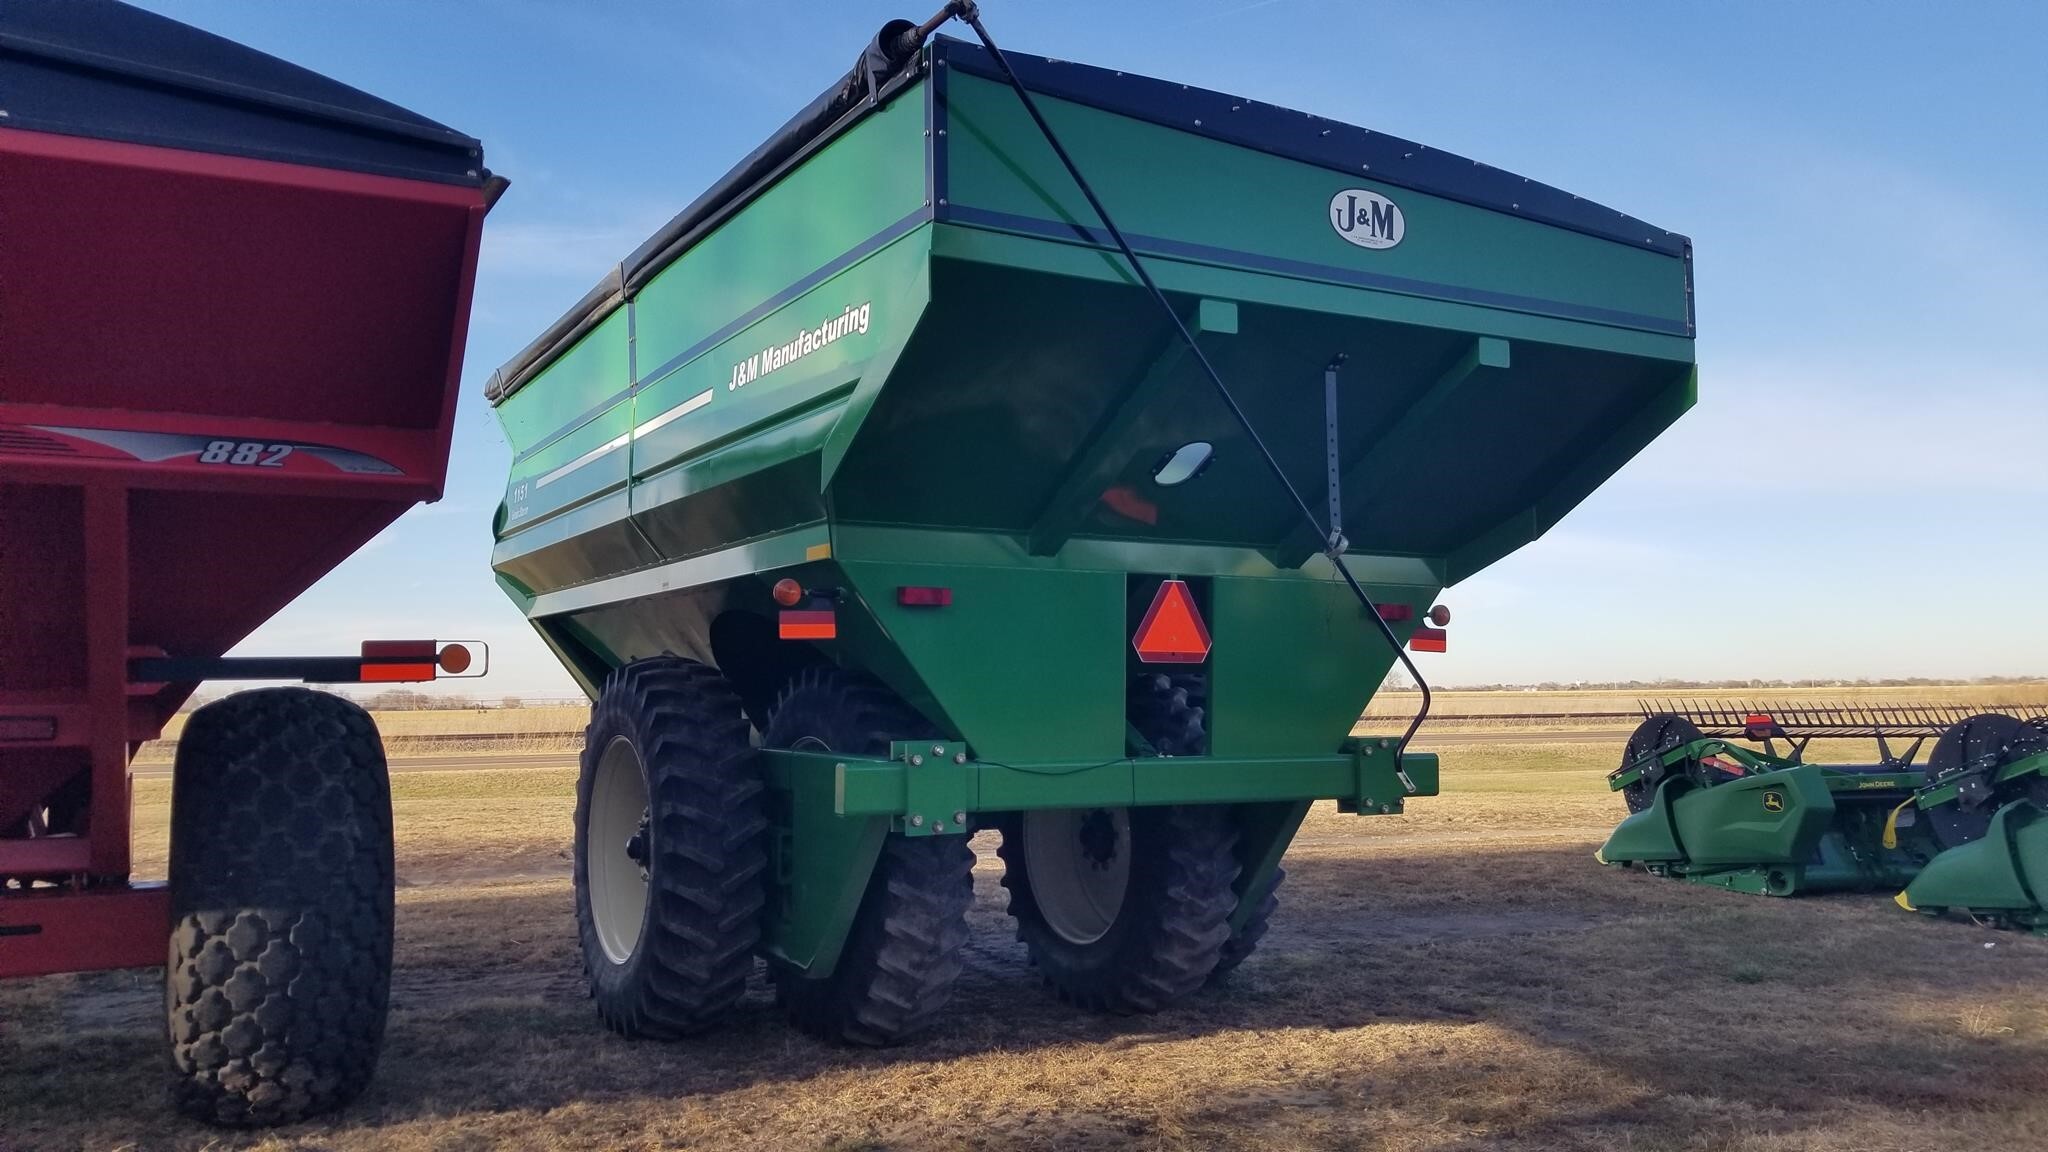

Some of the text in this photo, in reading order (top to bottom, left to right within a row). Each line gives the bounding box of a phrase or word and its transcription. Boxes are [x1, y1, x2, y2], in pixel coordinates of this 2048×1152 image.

[1336, 195, 1395, 241] J&M
[729, 302, 871, 391] J&M Manufacturing
[200, 441, 293, 466] 882
[514, 483, 528, 503] 1151
